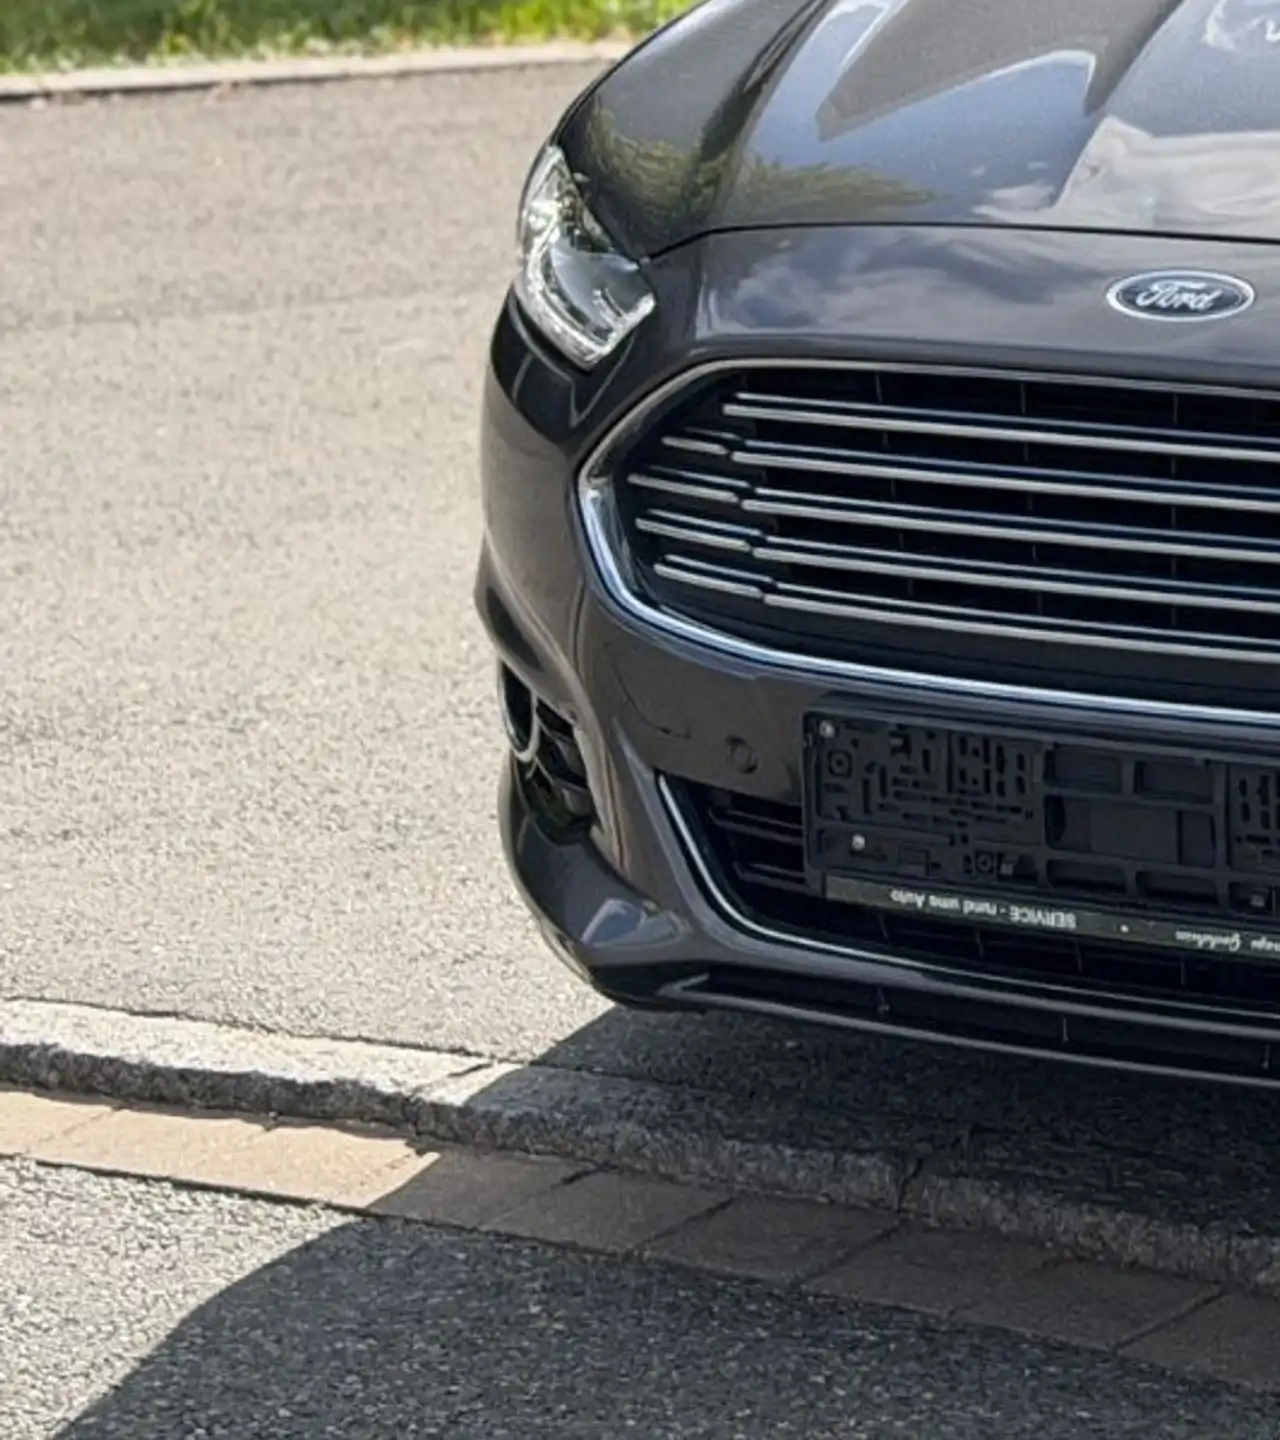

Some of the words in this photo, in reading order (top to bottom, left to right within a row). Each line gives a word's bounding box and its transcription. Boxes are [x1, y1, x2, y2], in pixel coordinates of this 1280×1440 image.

[1135, 278, 1223, 311] Ford
[889, 888, 926, 909] Auto
[929, 894, 960, 910] ums
[963, 899, 998, 917] rund
[1009, 905, 1077, 930] SERVICE
